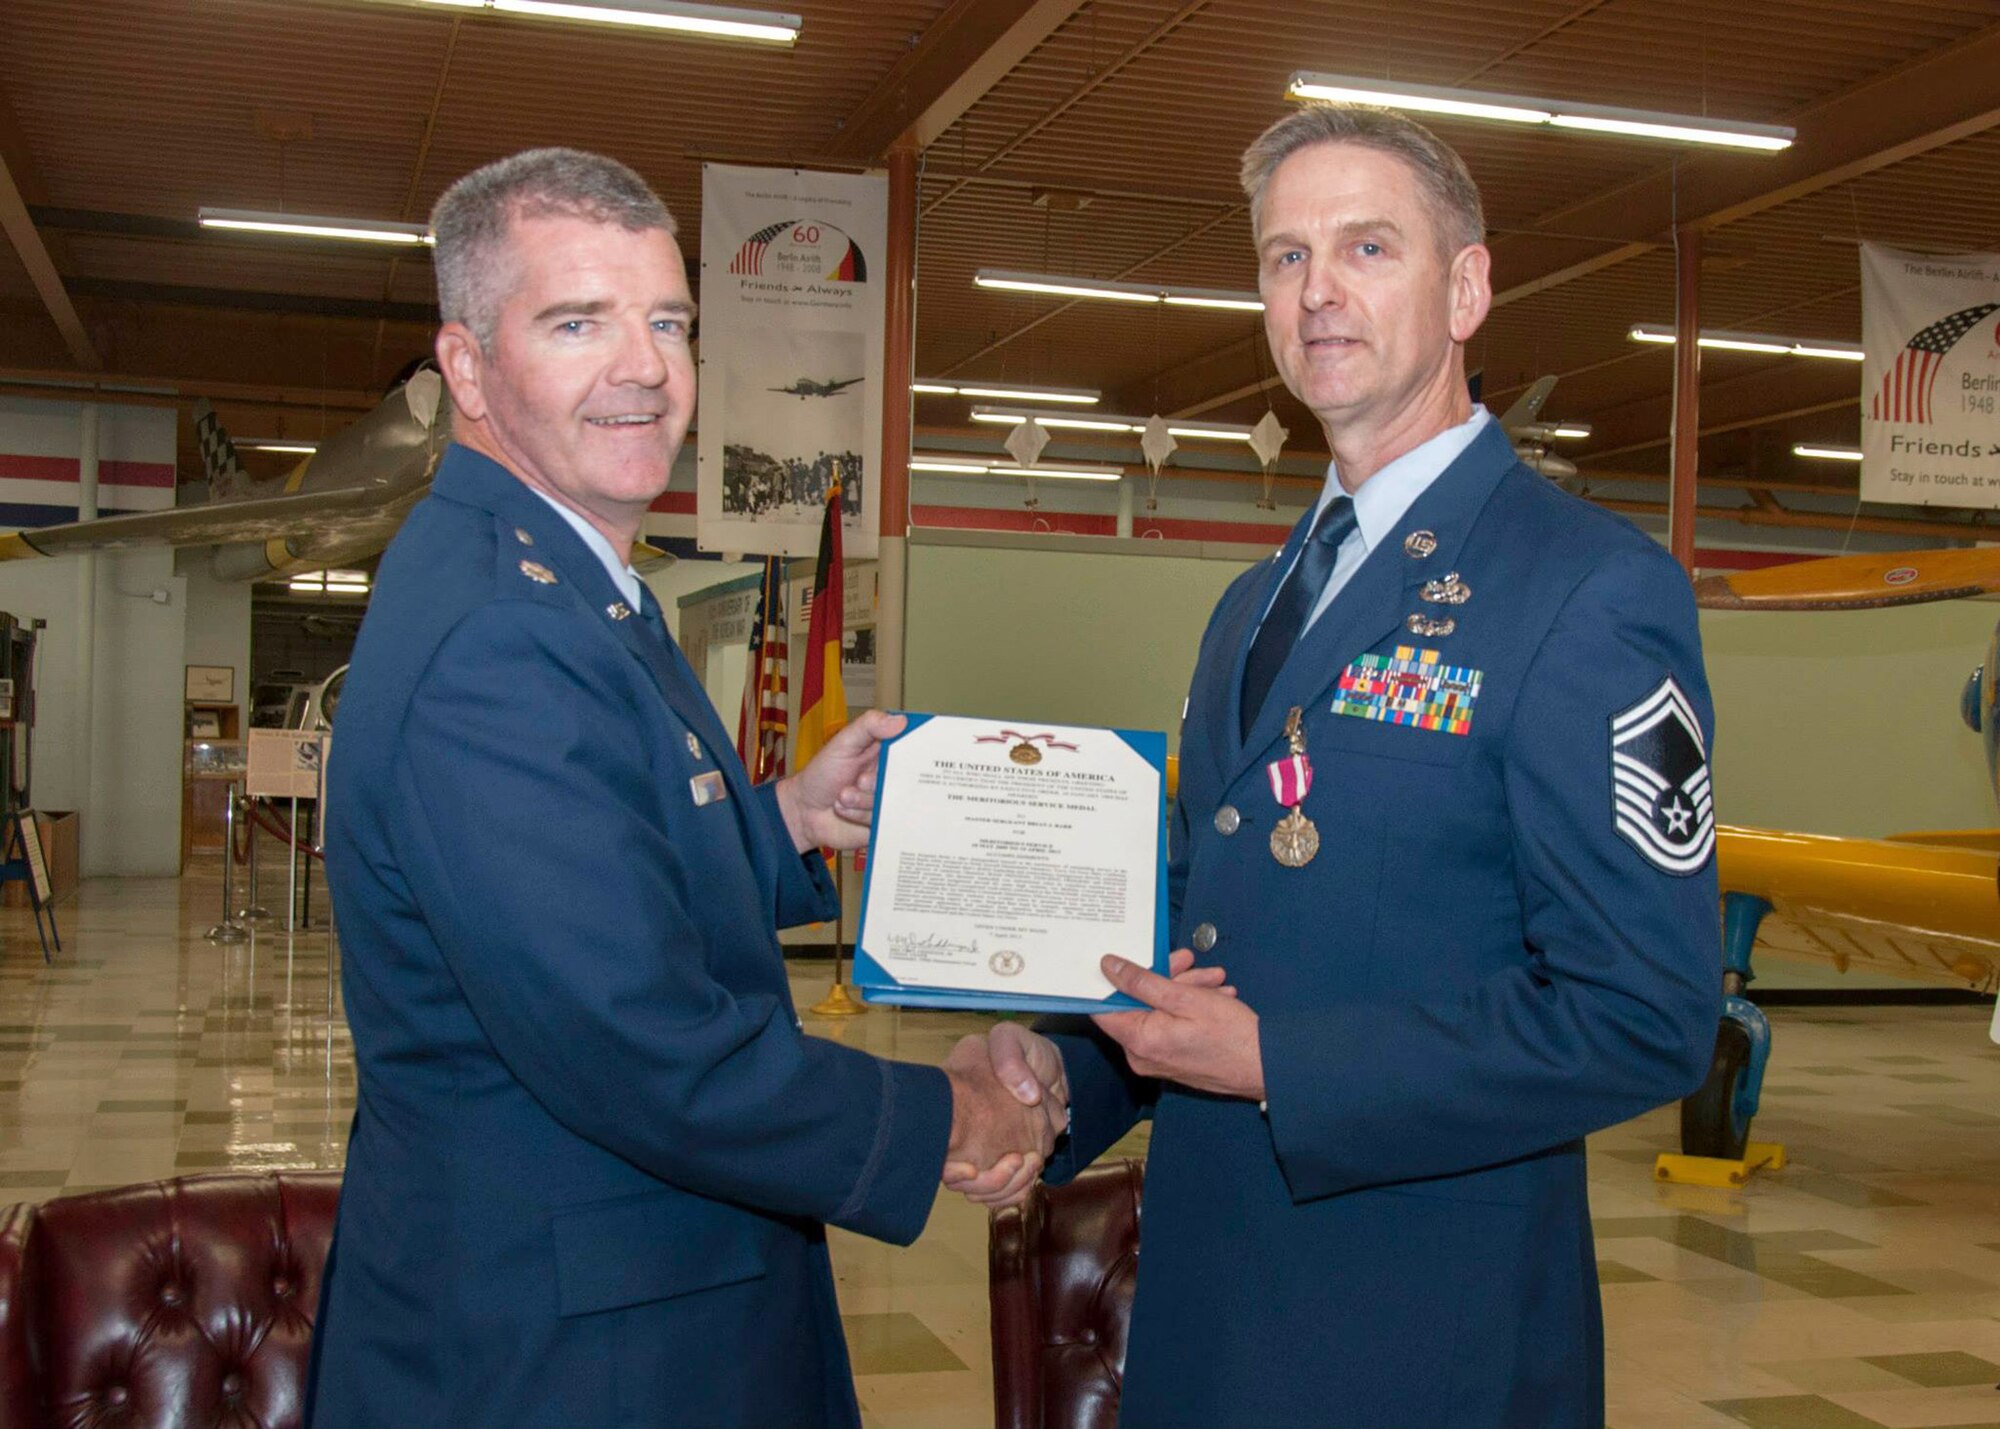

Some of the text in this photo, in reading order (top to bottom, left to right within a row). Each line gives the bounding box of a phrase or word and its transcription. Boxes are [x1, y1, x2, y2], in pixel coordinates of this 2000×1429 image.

[1904, 264, 1922, 276] The
[740, 280, 852, 297] Friends Always
[1962, 394, 1994, 414] 1948
[1891, 435, 1981, 458] Friends
[1890, 468, 1914, 486] Stay
[1919, 472, 1930, 483] in
[1934, 474, 1969, 486] touch
[1972, 476, 1984, 487] at
[934, 760, 956, 769] THE
[959, 762, 1002, 772] UNITED
[1004, 766, 1043, 777] STATES
[1046, 770, 1061, 778] OF
[1063, 772, 1115, 782] AMERICA
